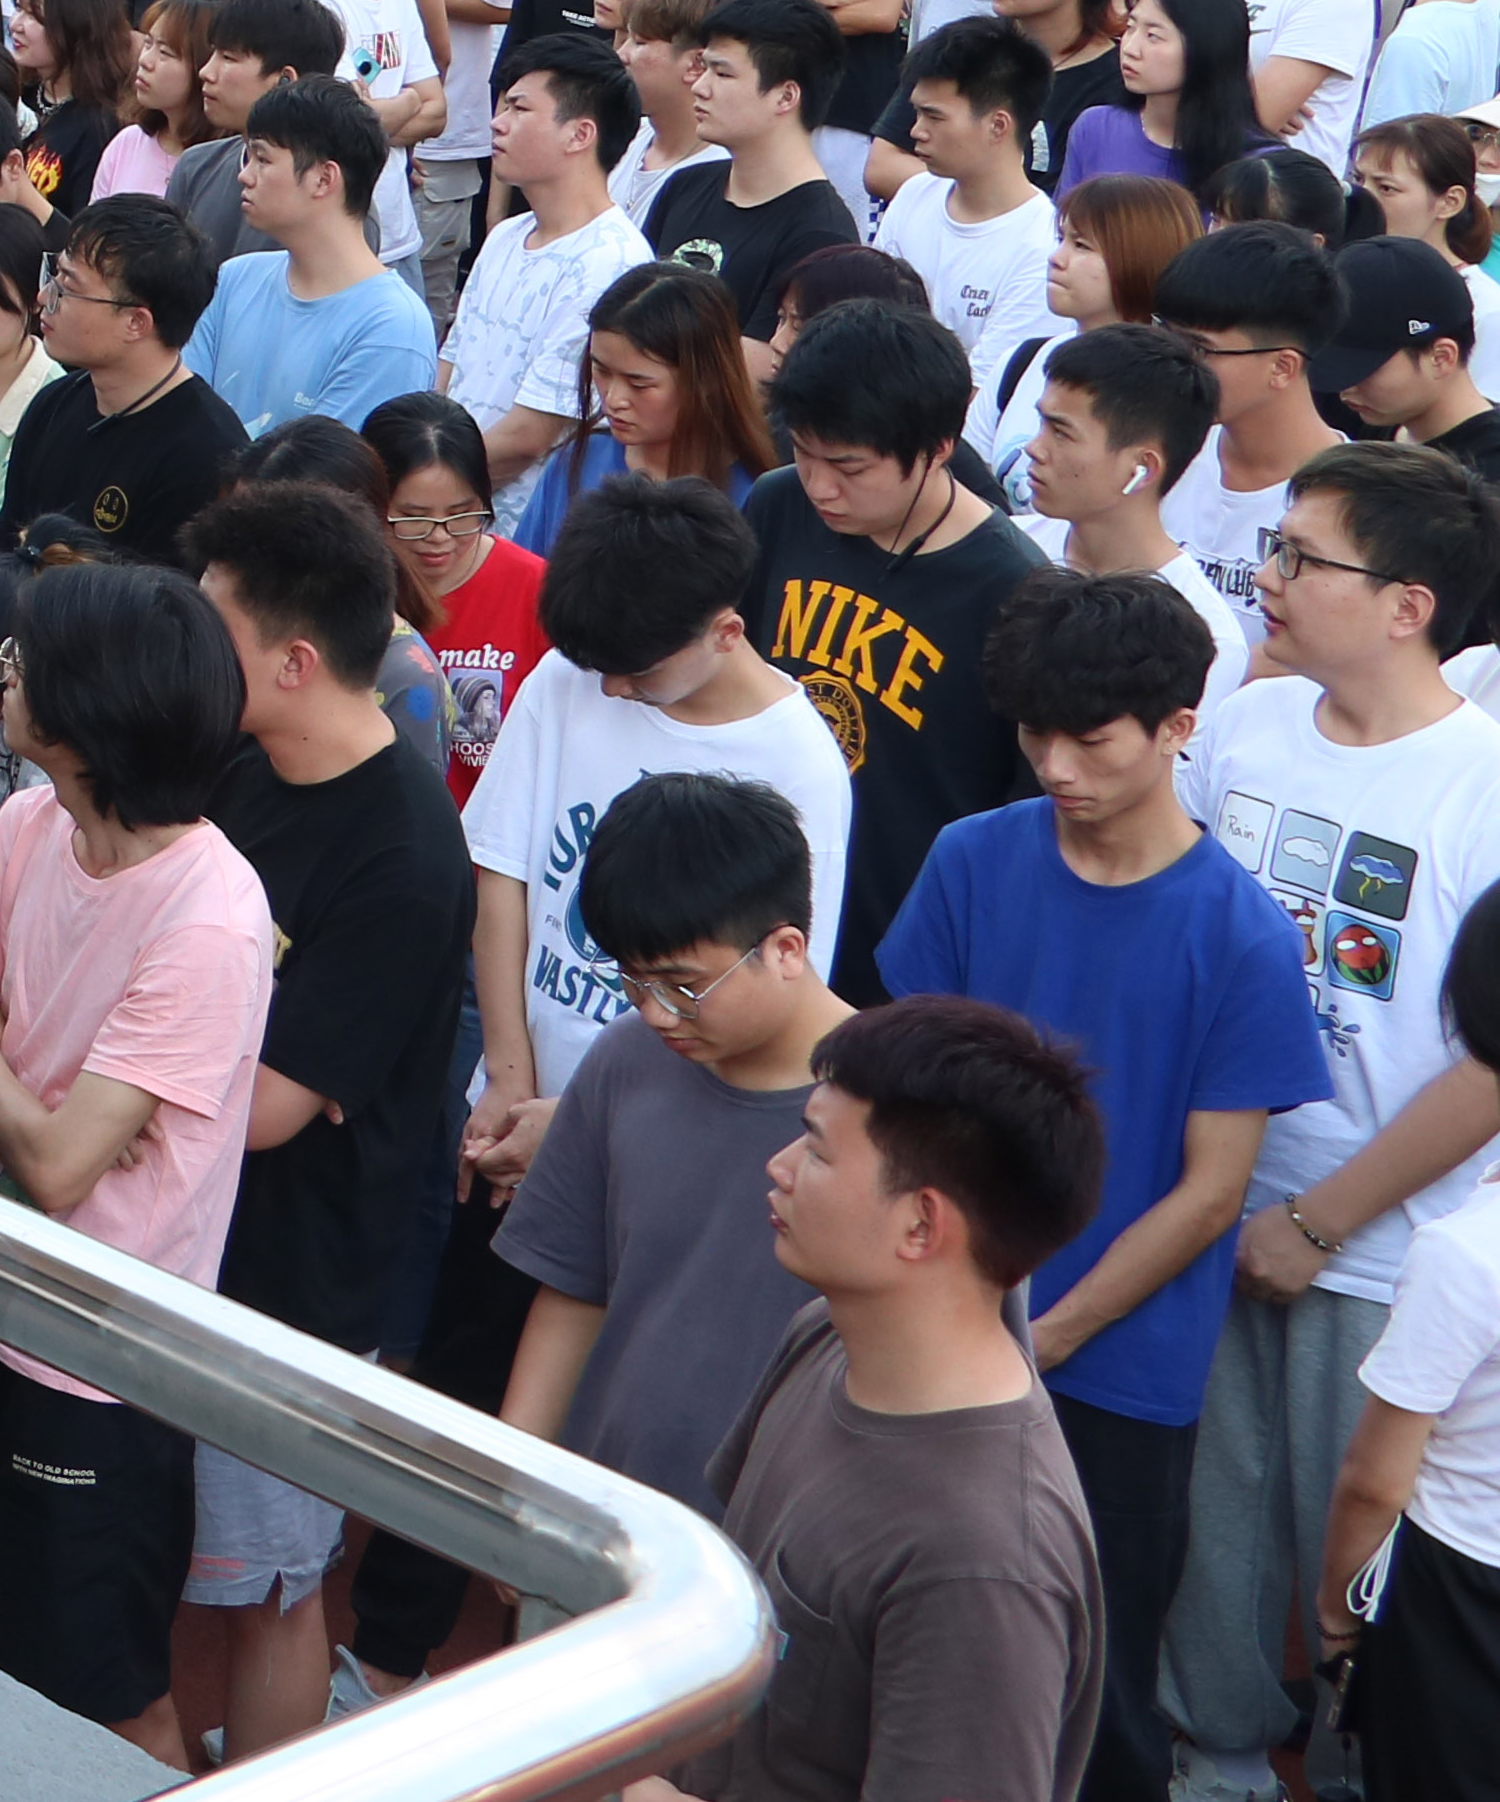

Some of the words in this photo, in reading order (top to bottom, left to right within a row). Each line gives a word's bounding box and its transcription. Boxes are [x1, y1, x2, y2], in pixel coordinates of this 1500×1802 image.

[439, 643, 515, 671] make
[772, 578, 944, 731] NIKE
[1227, 814, 1255, 842] Rain
[33, 1461, 44, 1471] TO
[45, 1464, 62, 1475] OLD
[63, 1466, 97, 1477] SCHOOL
